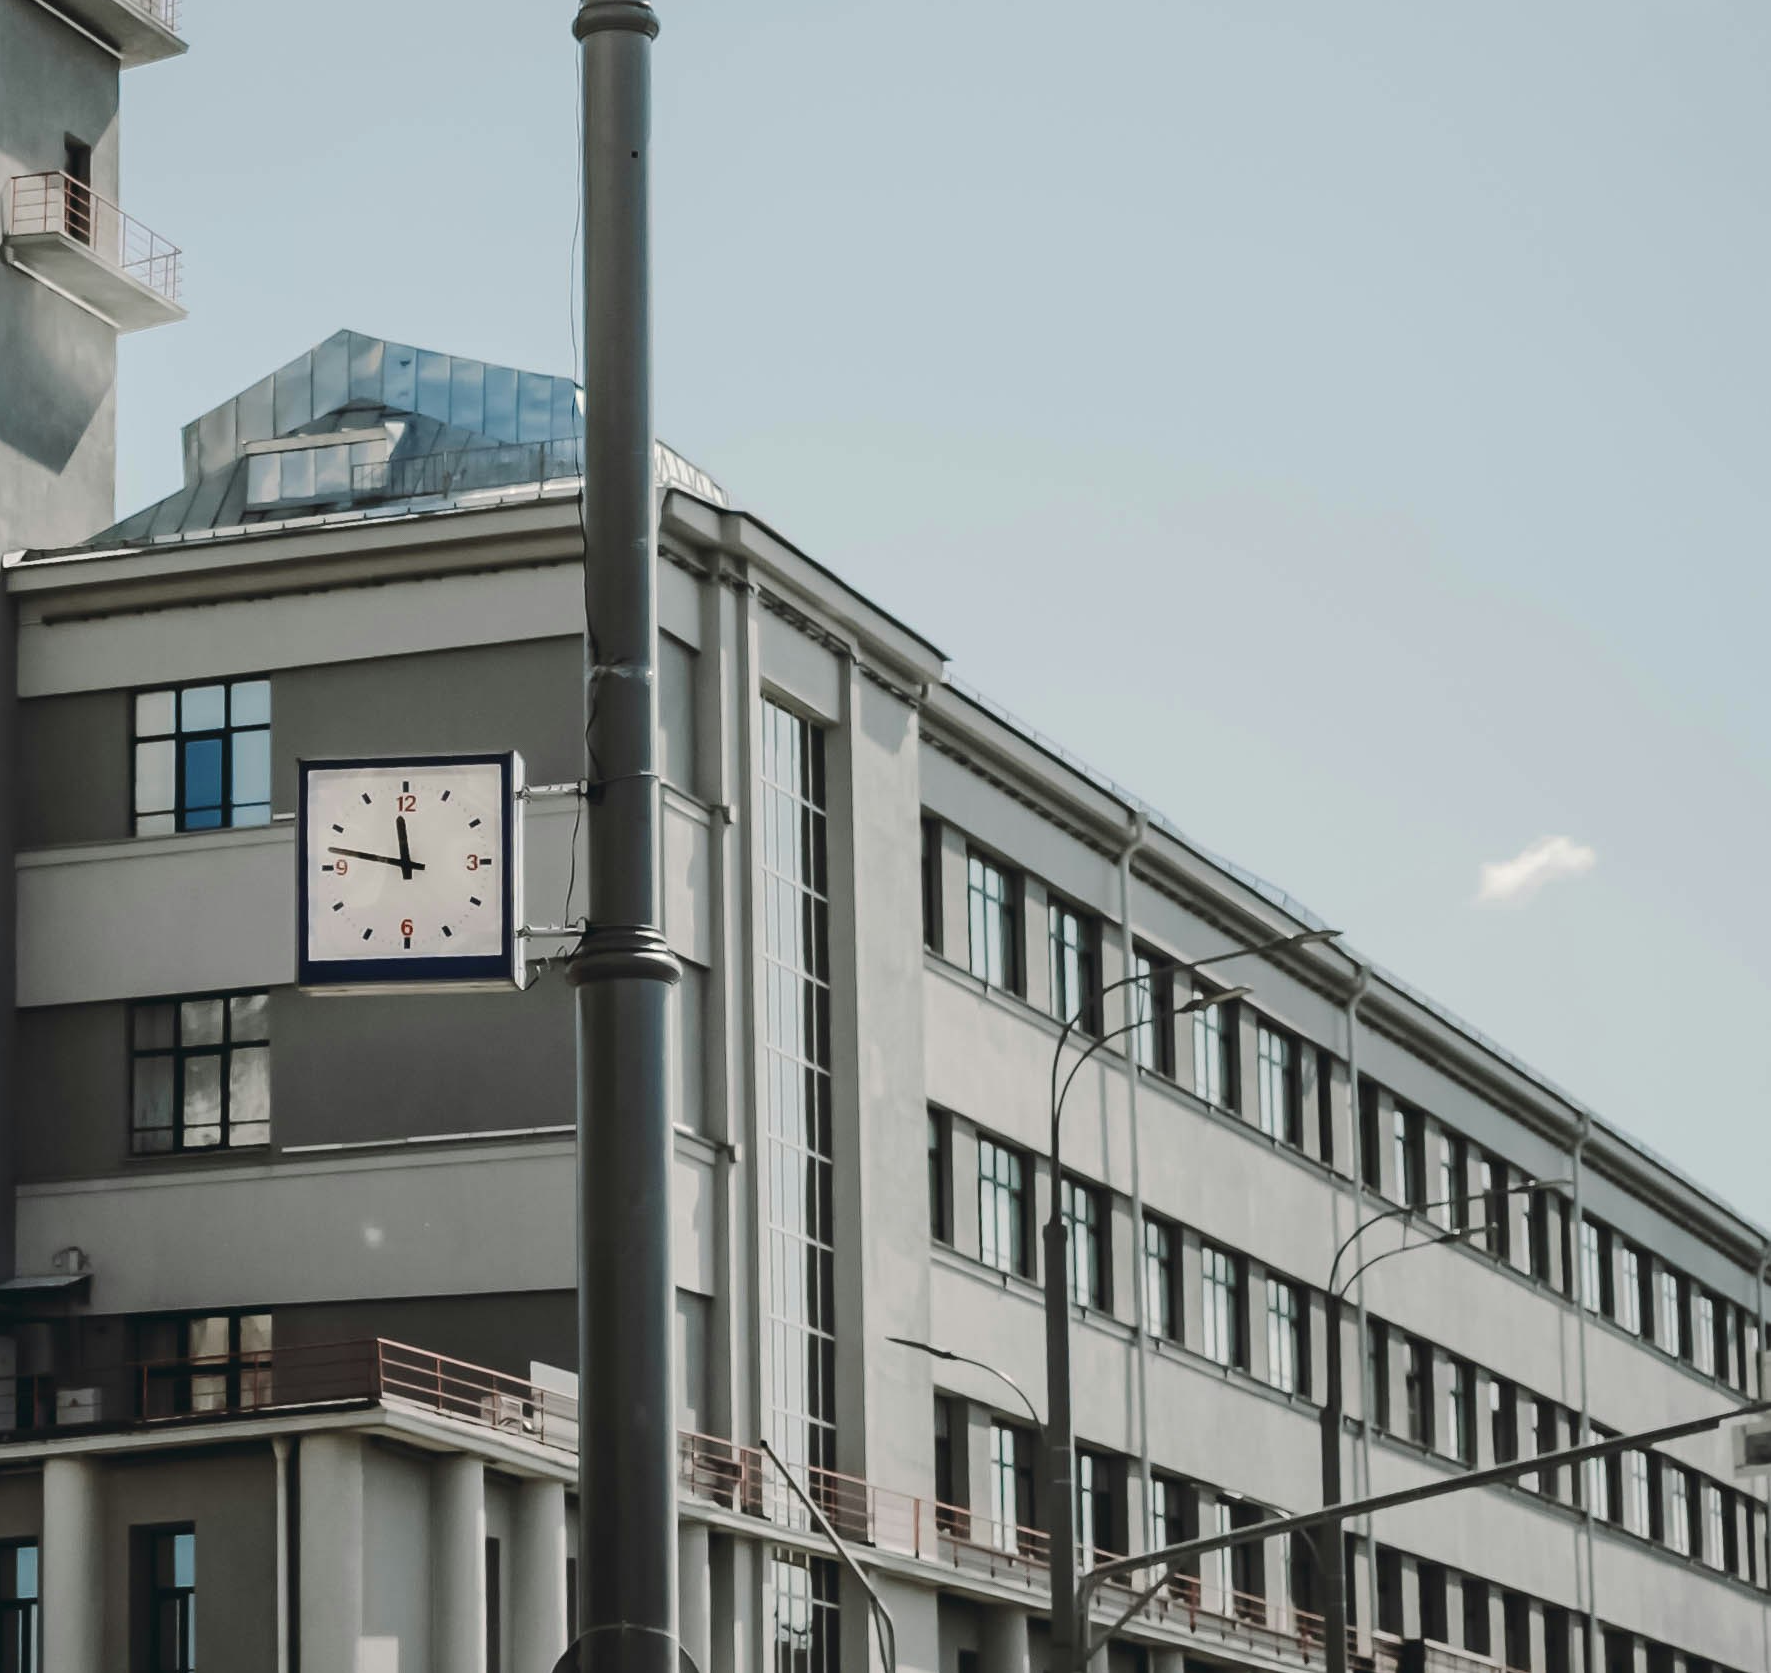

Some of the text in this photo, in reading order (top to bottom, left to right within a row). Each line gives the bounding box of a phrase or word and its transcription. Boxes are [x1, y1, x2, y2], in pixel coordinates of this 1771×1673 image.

[396, 795, 417, 813] 12
[335, 860, 348, 876] 9
[466, 854, 479, 871] 3
[400, 918, 414, 937] 6
